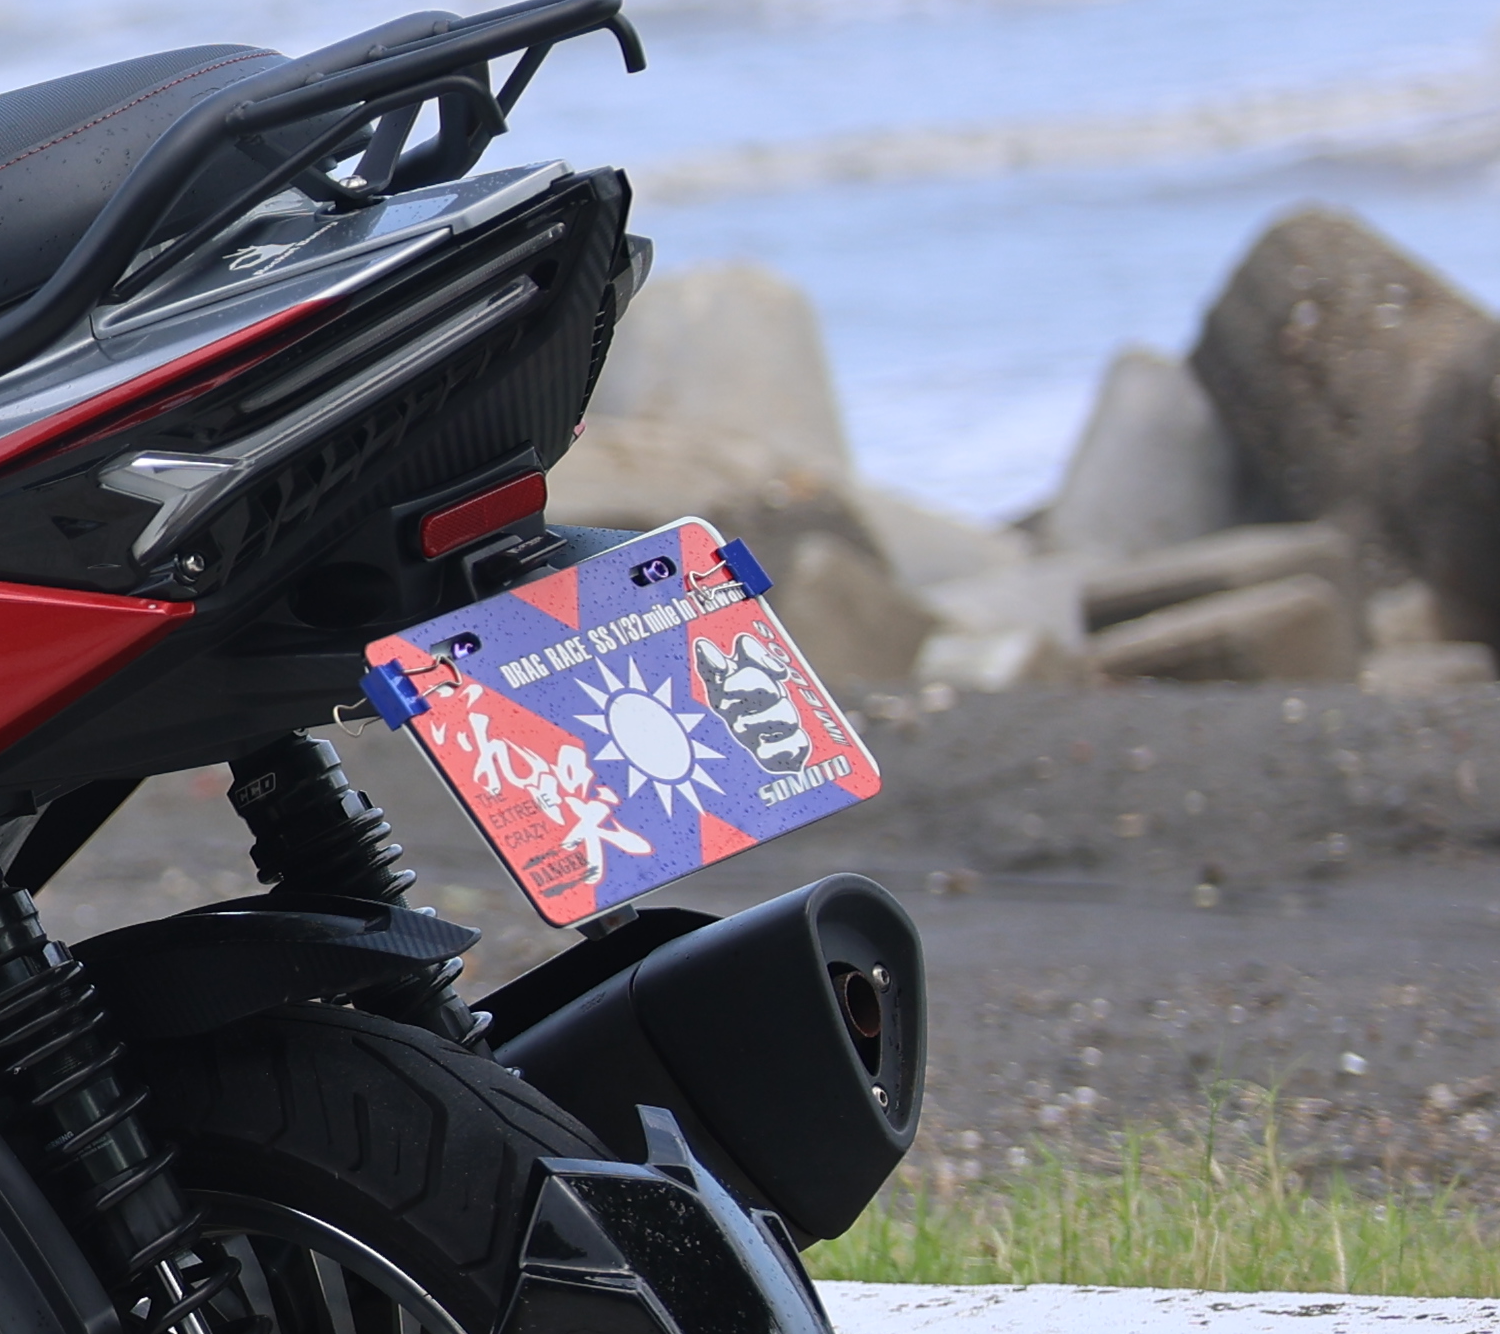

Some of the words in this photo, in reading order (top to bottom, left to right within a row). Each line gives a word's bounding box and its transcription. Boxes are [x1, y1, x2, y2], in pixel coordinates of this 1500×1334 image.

[500, 659, 551, 689] DRAG
[544, 636, 593, 671] RACE
[587, 622, 618, 655] SS
[609, 612, 650, 646] 1/32
[642, 601, 682, 634] mile
[671, 597, 698, 622] In
[685, 578, 748, 615] Taiwan
[475, 787, 508, 809] THE
[758, 754, 852, 807] SOMOTO
[488, 791, 556, 830] EXTREME
[504, 821, 551, 851] CRAZY
[530, 851, 590, 888] DANGER
